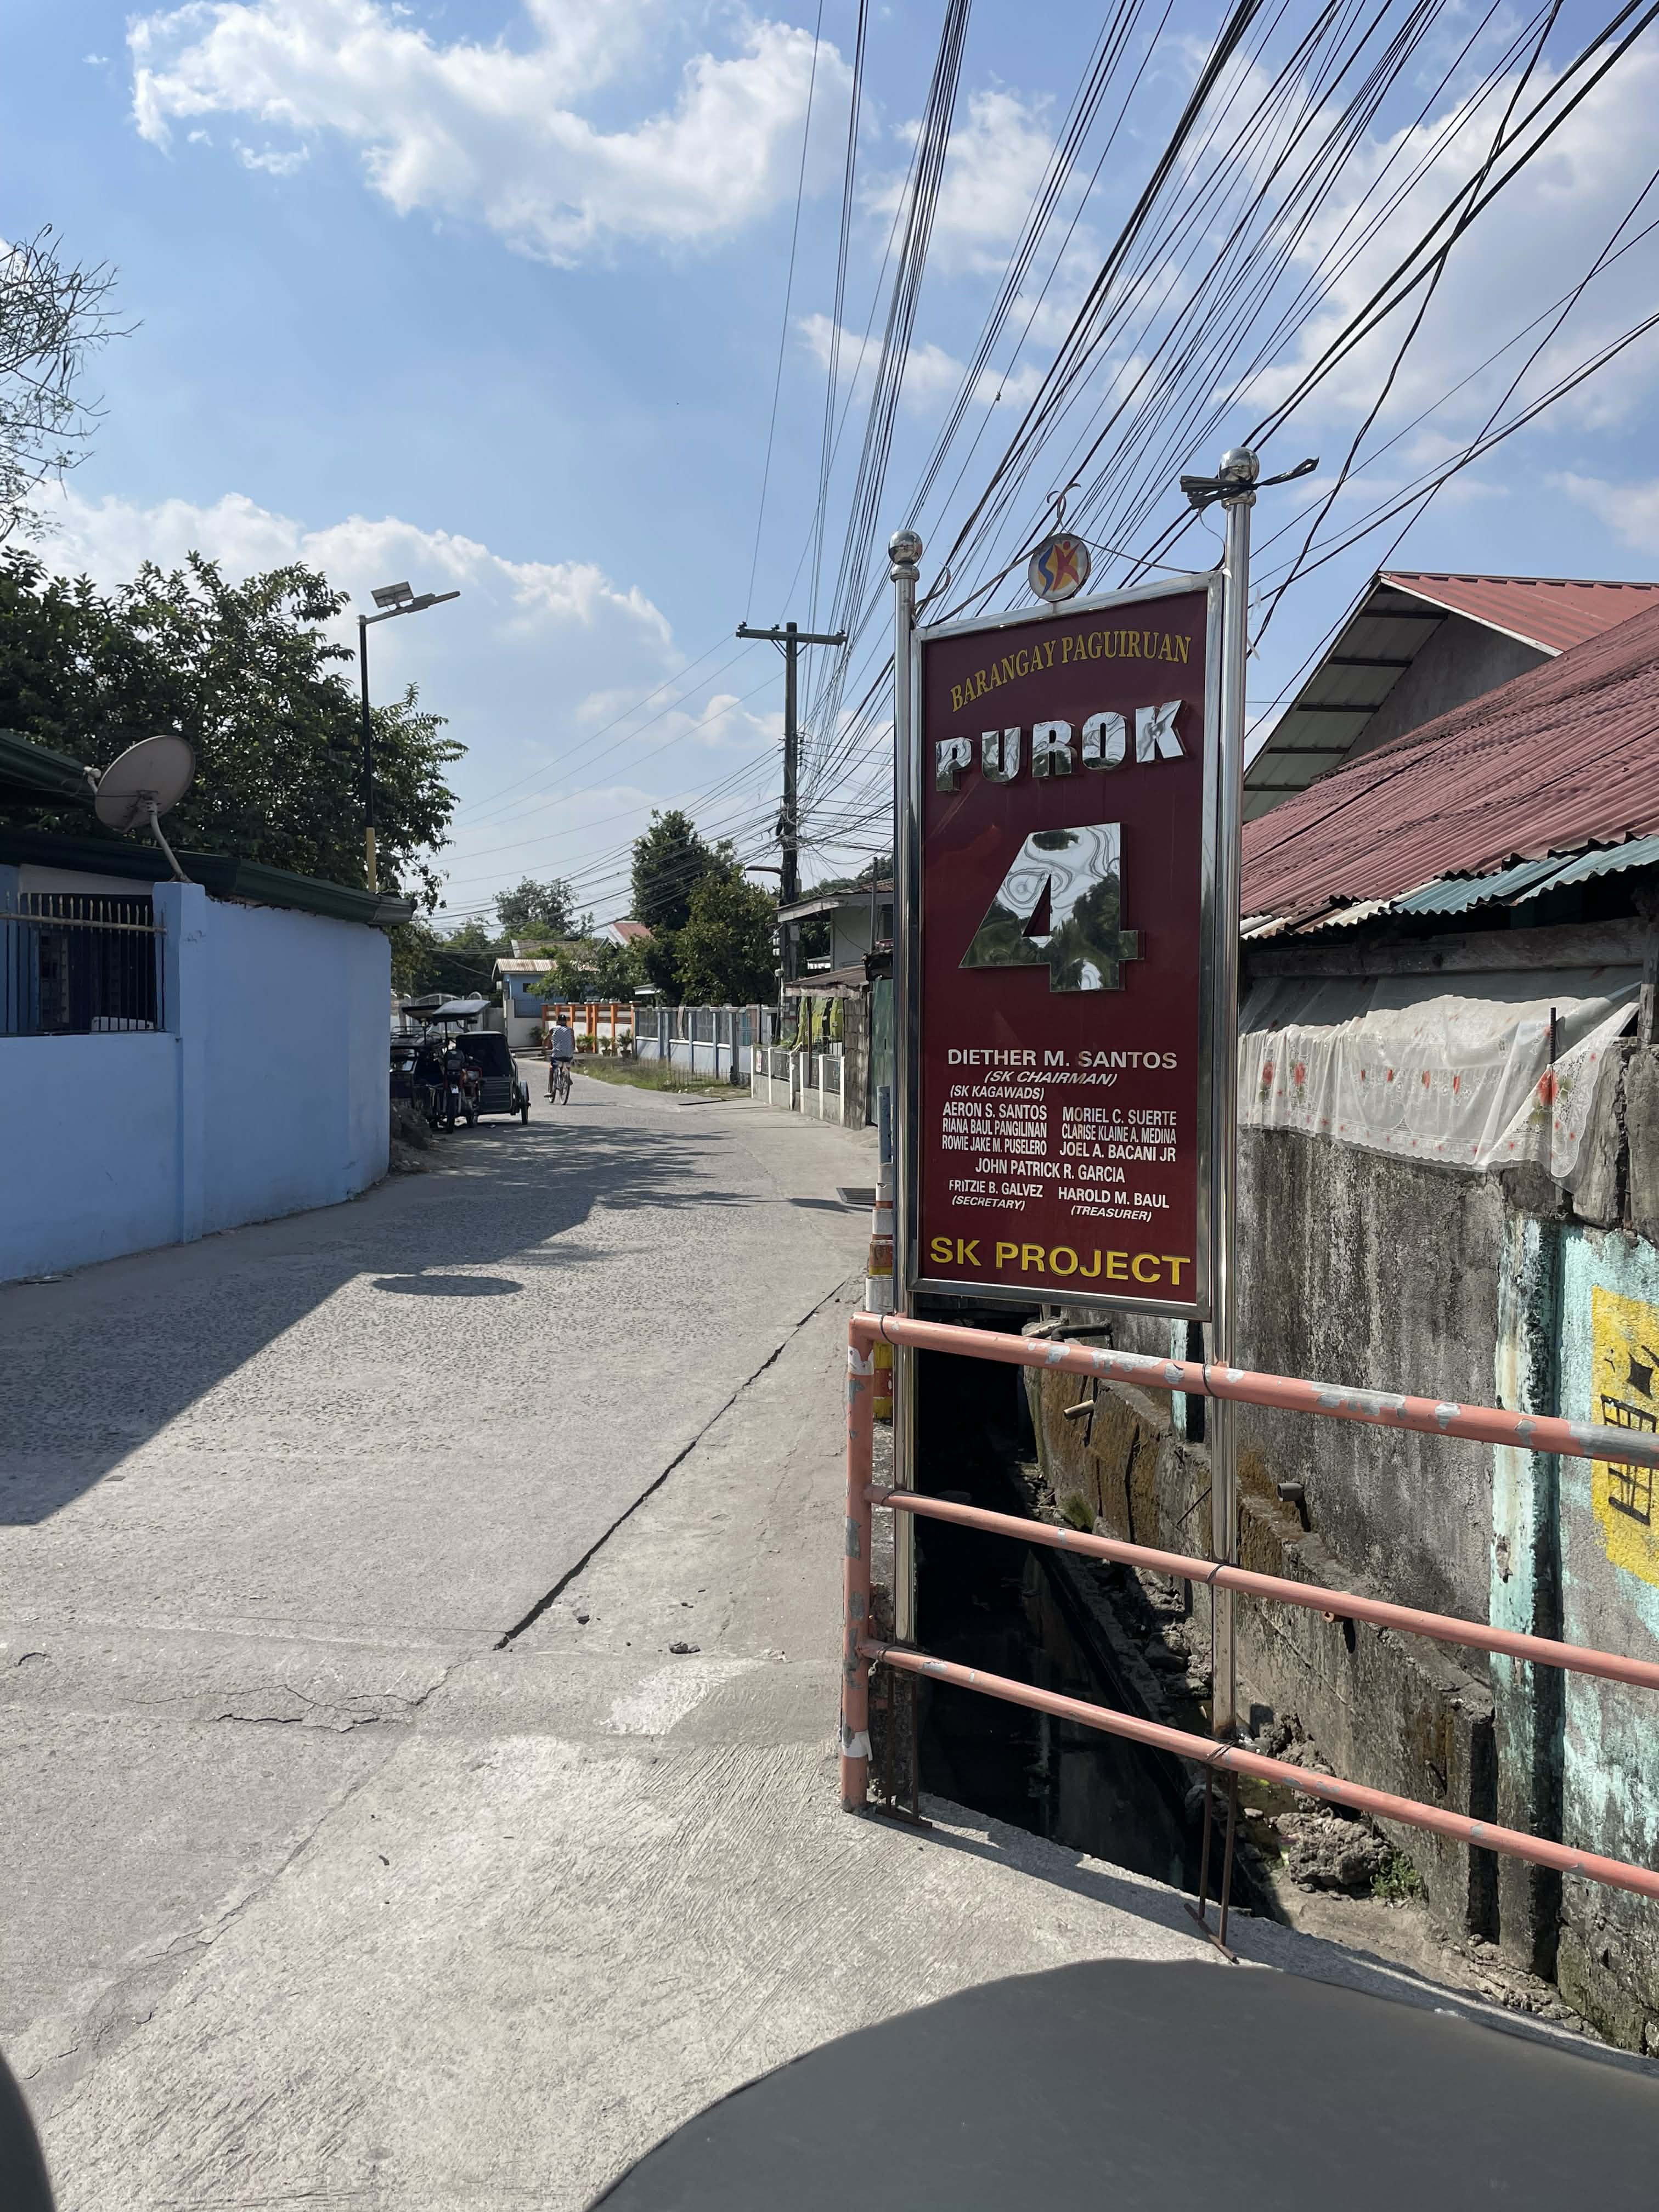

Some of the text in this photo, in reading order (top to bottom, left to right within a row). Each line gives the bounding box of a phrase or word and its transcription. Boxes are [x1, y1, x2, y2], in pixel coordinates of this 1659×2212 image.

[950, 630, 1192, 712] BARANGAY PAGUIRUAN
[935, 699, 1187, 792] PUROK
[958, 822, 1144, 992] 4
[948, 1049, 1177, 1069] DIETHER M. SANTOS
[984, 1071, 1118, 1087] (SK CHAIRMAN)
[950, 1085, 1044, 1101] (SK KAGAWADS)
[943, 1102, 1047, 1120] AERON S. SANTOS
[1063, 1107, 1177, 1126] MORIEL C. SUERTE
[943, 1118, 1047, 1138] RIANA BAUL PANGILINAN
[1062, 1124, 1176, 1144] CLARISE KLAINE A. MEDINA
[943, 1135, 1047, 1155] ROWIE JAKE M. PUSELERO
[1059, 1142, 1176, 1162] JOEL A. BACANI JR
[975, 1158, 1125, 1183] JOHN PATRICK R. GARCIA
[949, 1180, 1043, 1198] FRITZIE B. GALVEZ
[1058, 1187, 1170, 1208] HAROLD M. BAUL
[952, 1195, 1025, 1211] (SECRETARY)
[1071, 1205, 1152, 1222] (TREASURER)
[930, 1237, 1190, 1285] SK PROJECT
